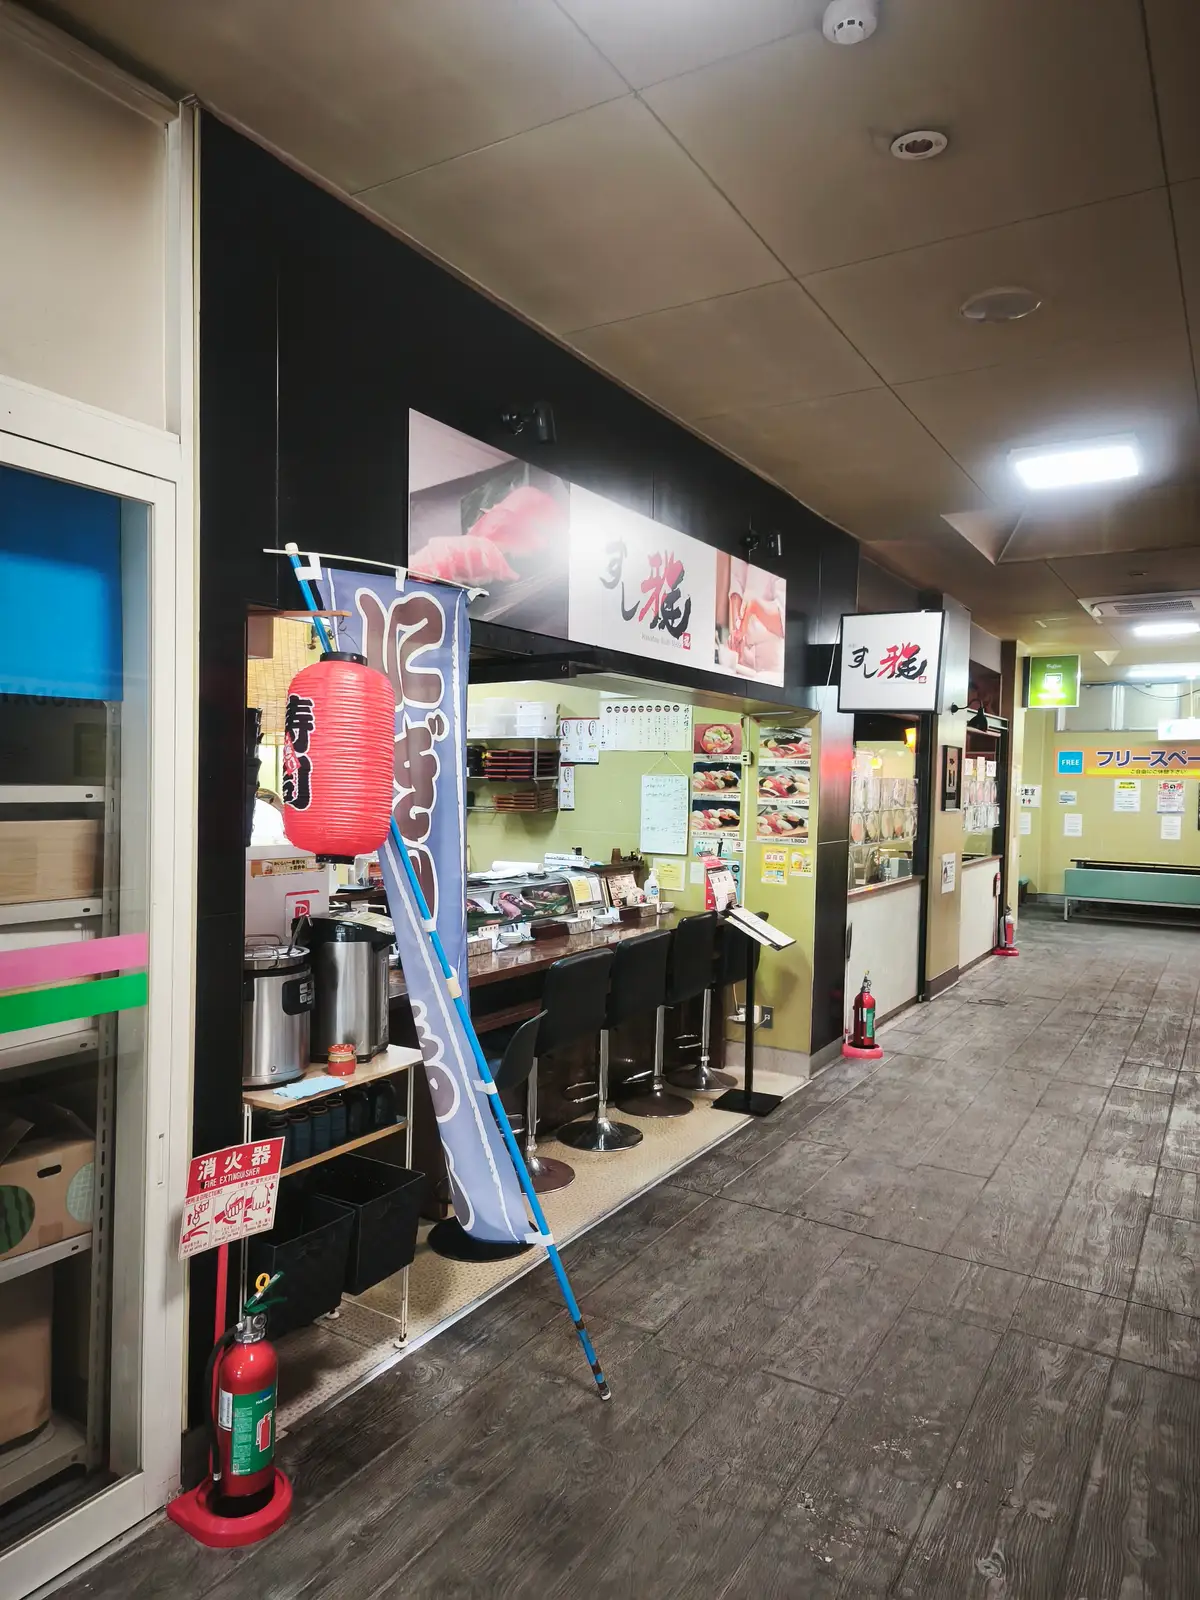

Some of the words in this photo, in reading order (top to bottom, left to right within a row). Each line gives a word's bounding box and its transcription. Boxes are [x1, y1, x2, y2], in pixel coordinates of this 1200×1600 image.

[197, 1145, 271, 1181] 消火器
[204, 1178, 217, 1189] FIRE
[219, 1167, 260, 1184] EXTINGUISHER
